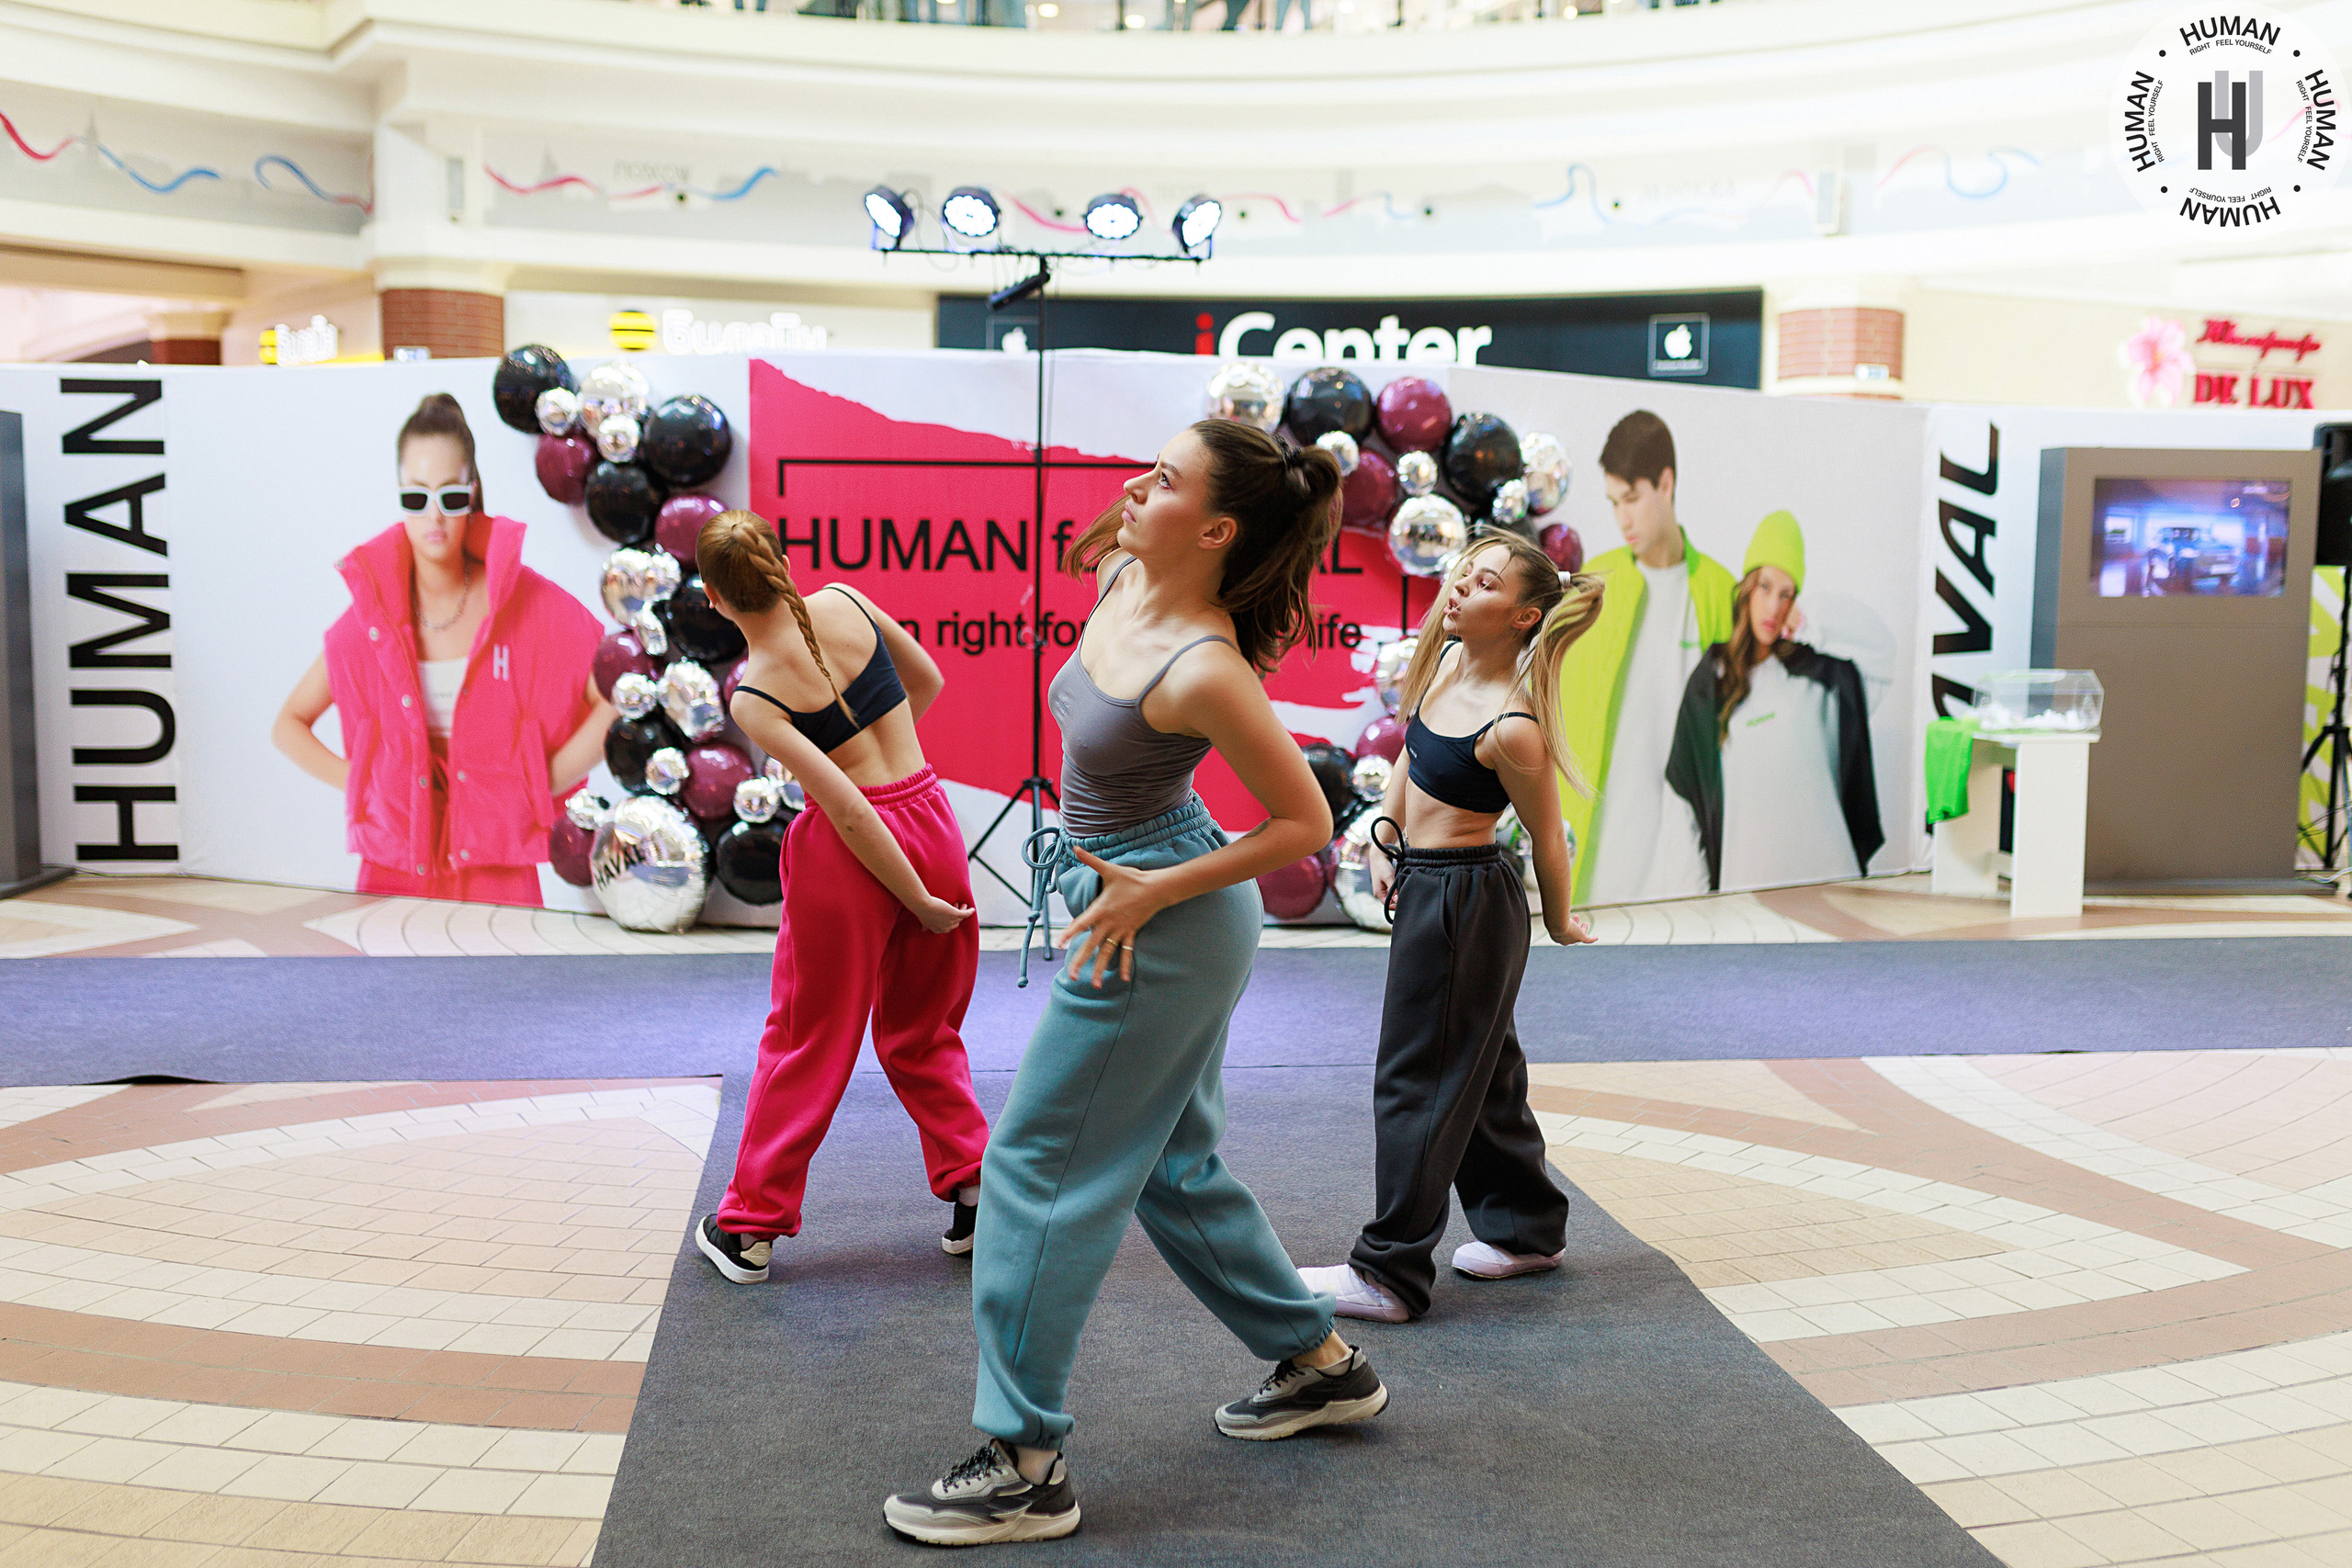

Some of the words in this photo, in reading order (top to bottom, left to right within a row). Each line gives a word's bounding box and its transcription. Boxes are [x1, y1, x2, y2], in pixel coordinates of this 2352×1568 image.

[1195, 311, 1493, 366] iCenter
[2194, 373, 2238, 404] DE
[2248, 376, 2314, 410] LUX
[778, 518, 1028, 572] HUMAN
[60, 378, 179, 861] HUMAN
[937, 612, 1026, 656] right
[493, 643, 510, 682] H
